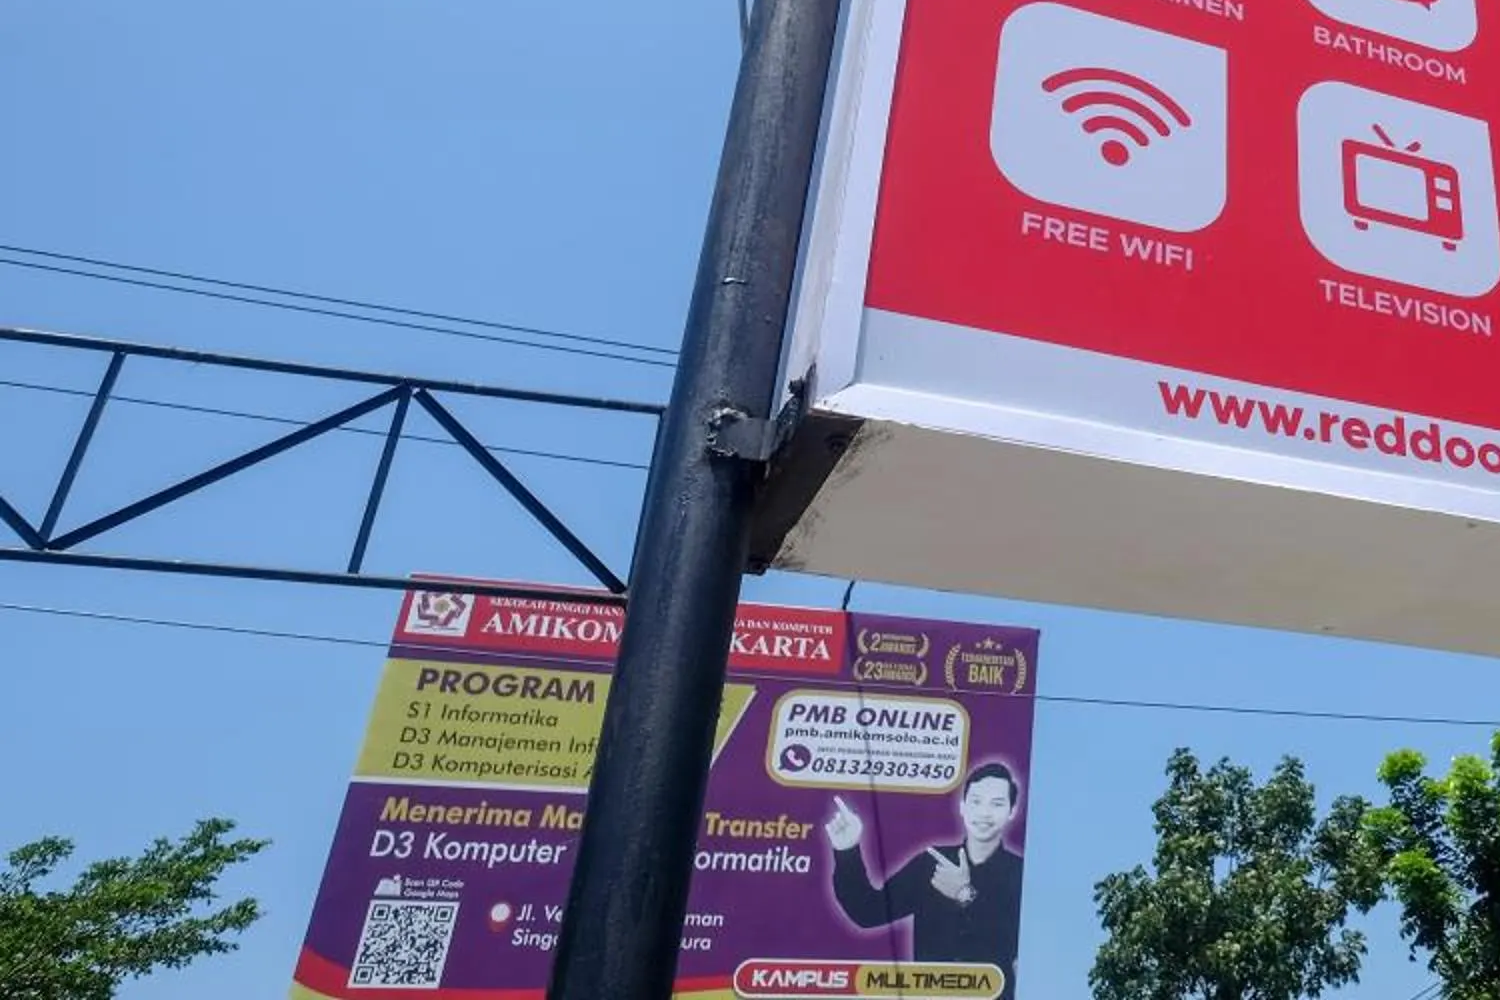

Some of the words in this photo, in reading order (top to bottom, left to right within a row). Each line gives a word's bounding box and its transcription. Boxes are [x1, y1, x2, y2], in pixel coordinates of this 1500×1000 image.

[1313, 25, 1467, 86] BATHROOM
[1021, 211, 1109, 253] FREE
[1120, 233, 1194, 271] WIFI
[1320, 279, 1492, 337] TELEVISION
[729, 632, 832, 661] KARTA
[416, 667, 596, 704] PROGRAM
[968, 663, 1004, 686] BAIK
[407, 700, 431, 719] S1
[441, 704, 559, 728] Informatika
[788, 703, 847, 725] PMB
[856, 707, 956, 731] ONLINE
[399, 727, 430, 745] D3
[437, 730, 561, 753] Manajemen
[784, 726, 960, 747] pmb.amikomsolo.ac.id
[392, 751, 425, 771] D3
[431, 753, 578, 778] Komputerisasi
[811, 756, 956, 780] 081329303450
[379, 796, 532, 828] Menerima
[705, 811, 814, 839] Transfer
[369, 829, 416, 859] D3
[423, 832, 567, 868] Komputer
[694, 845, 812, 873] ormatika
[751, 968, 850, 989] KAMPUS
[866, 971, 993, 991] MULTIMEDIA
